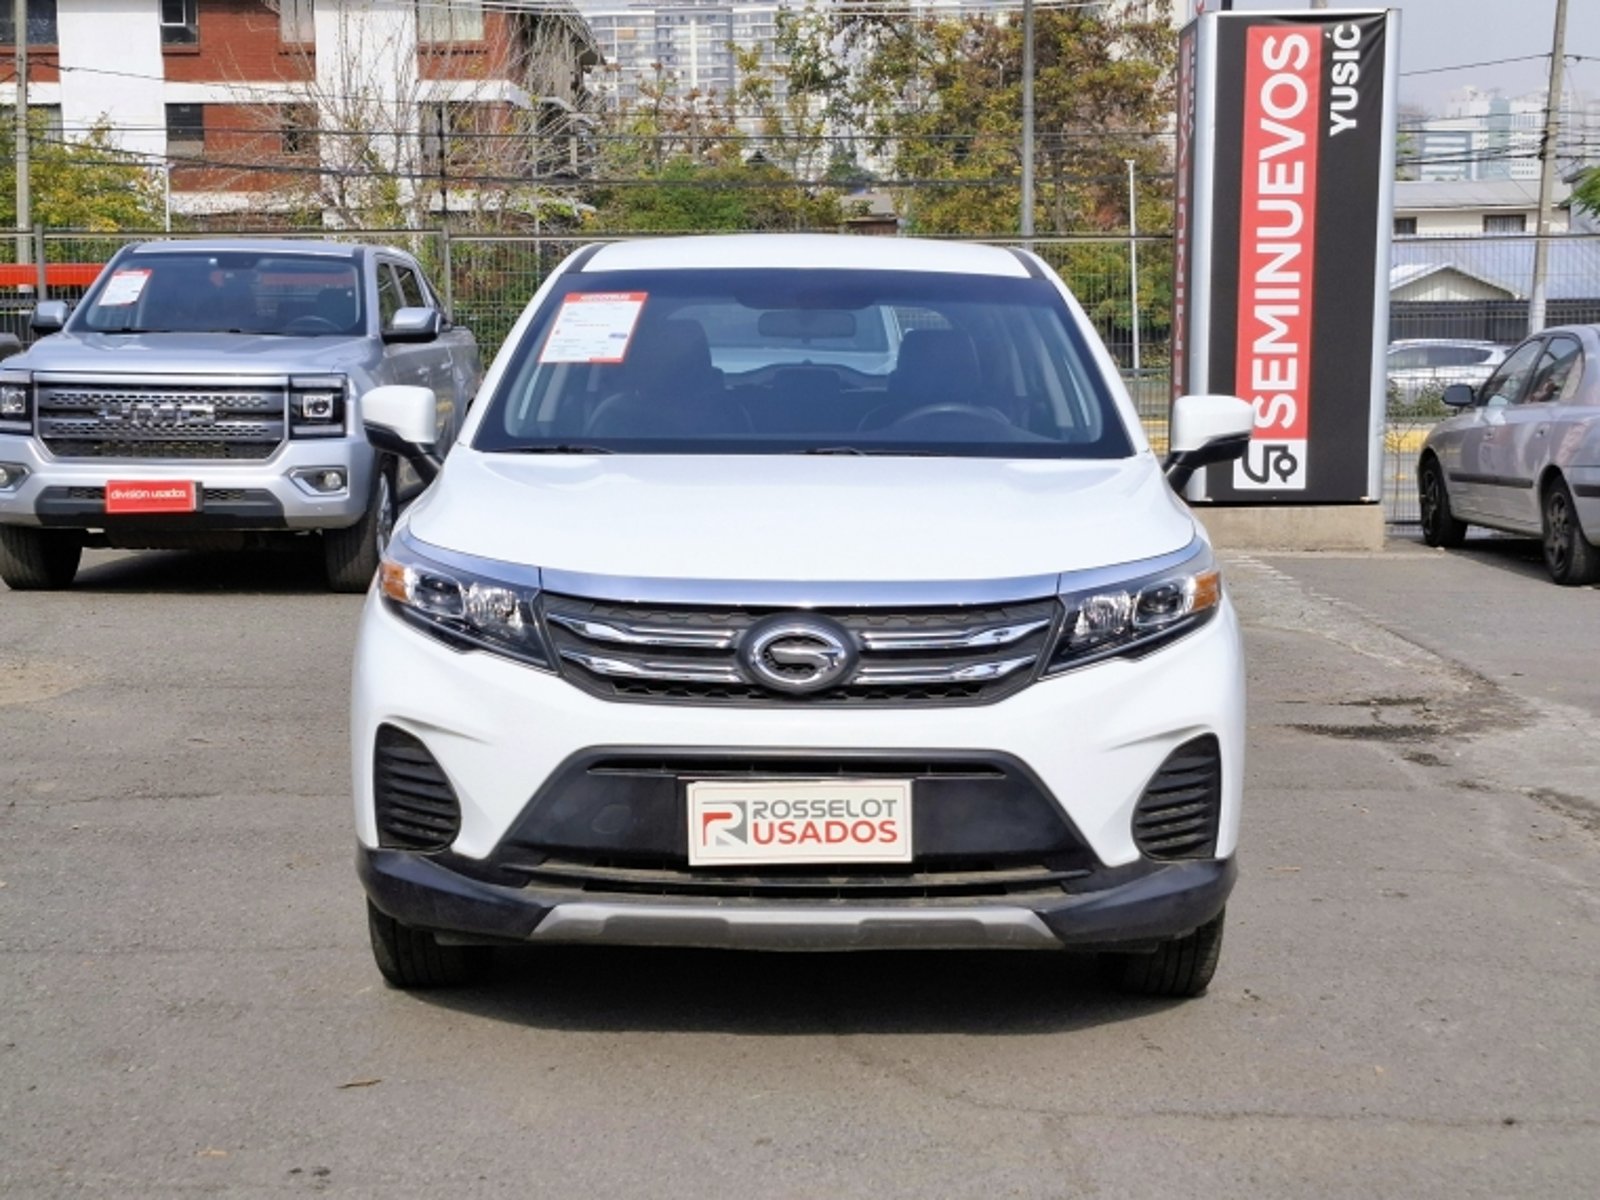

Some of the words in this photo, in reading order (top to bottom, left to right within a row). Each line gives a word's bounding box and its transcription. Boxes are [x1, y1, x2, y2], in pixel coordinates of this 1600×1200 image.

[1252, 33, 1311, 430] SEMINUEVOS
[151, 487, 187, 498] usados
[752, 799, 898, 820] ROSSELOT
[752, 820, 898, 845] USADOS
